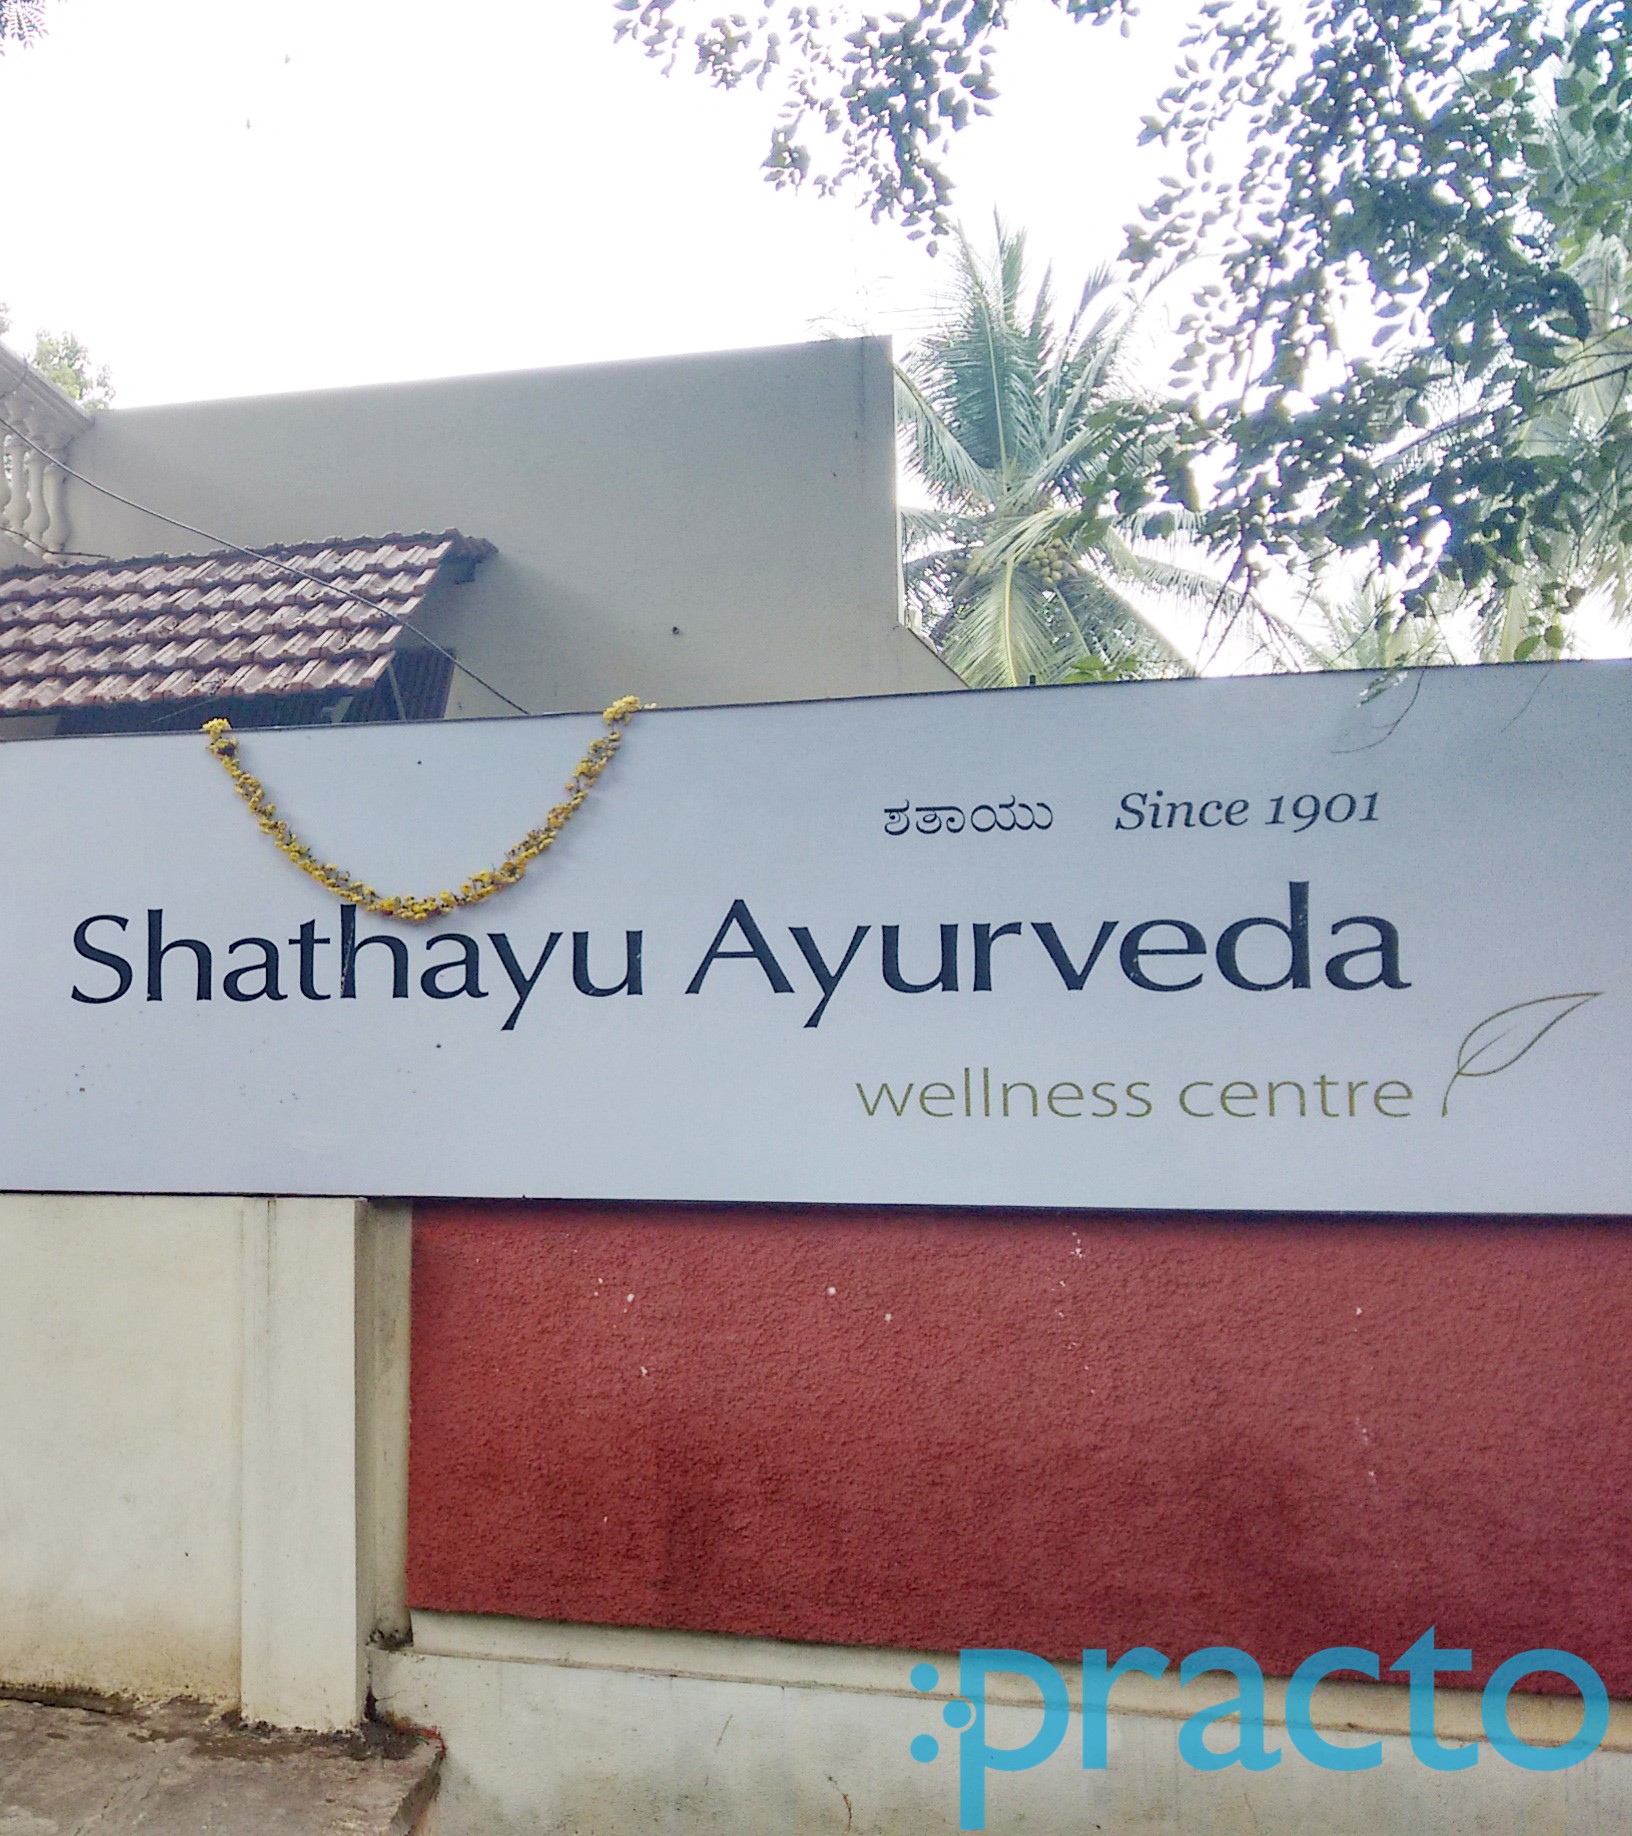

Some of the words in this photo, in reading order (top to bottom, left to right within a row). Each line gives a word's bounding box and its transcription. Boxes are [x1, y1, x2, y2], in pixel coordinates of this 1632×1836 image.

[884, 795, 1053, 836] ಶತಾಯು
[1115, 790, 1250, 830] Since
[1265, 792, 1380, 833] 1901
[70, 903, 644, 1031] Shathayu
[685, 881, 1412, 1028] Ayurveda
[855, 1067, 1152, 1118] wellness
[1178, 1073, 1414, 1118] centre
